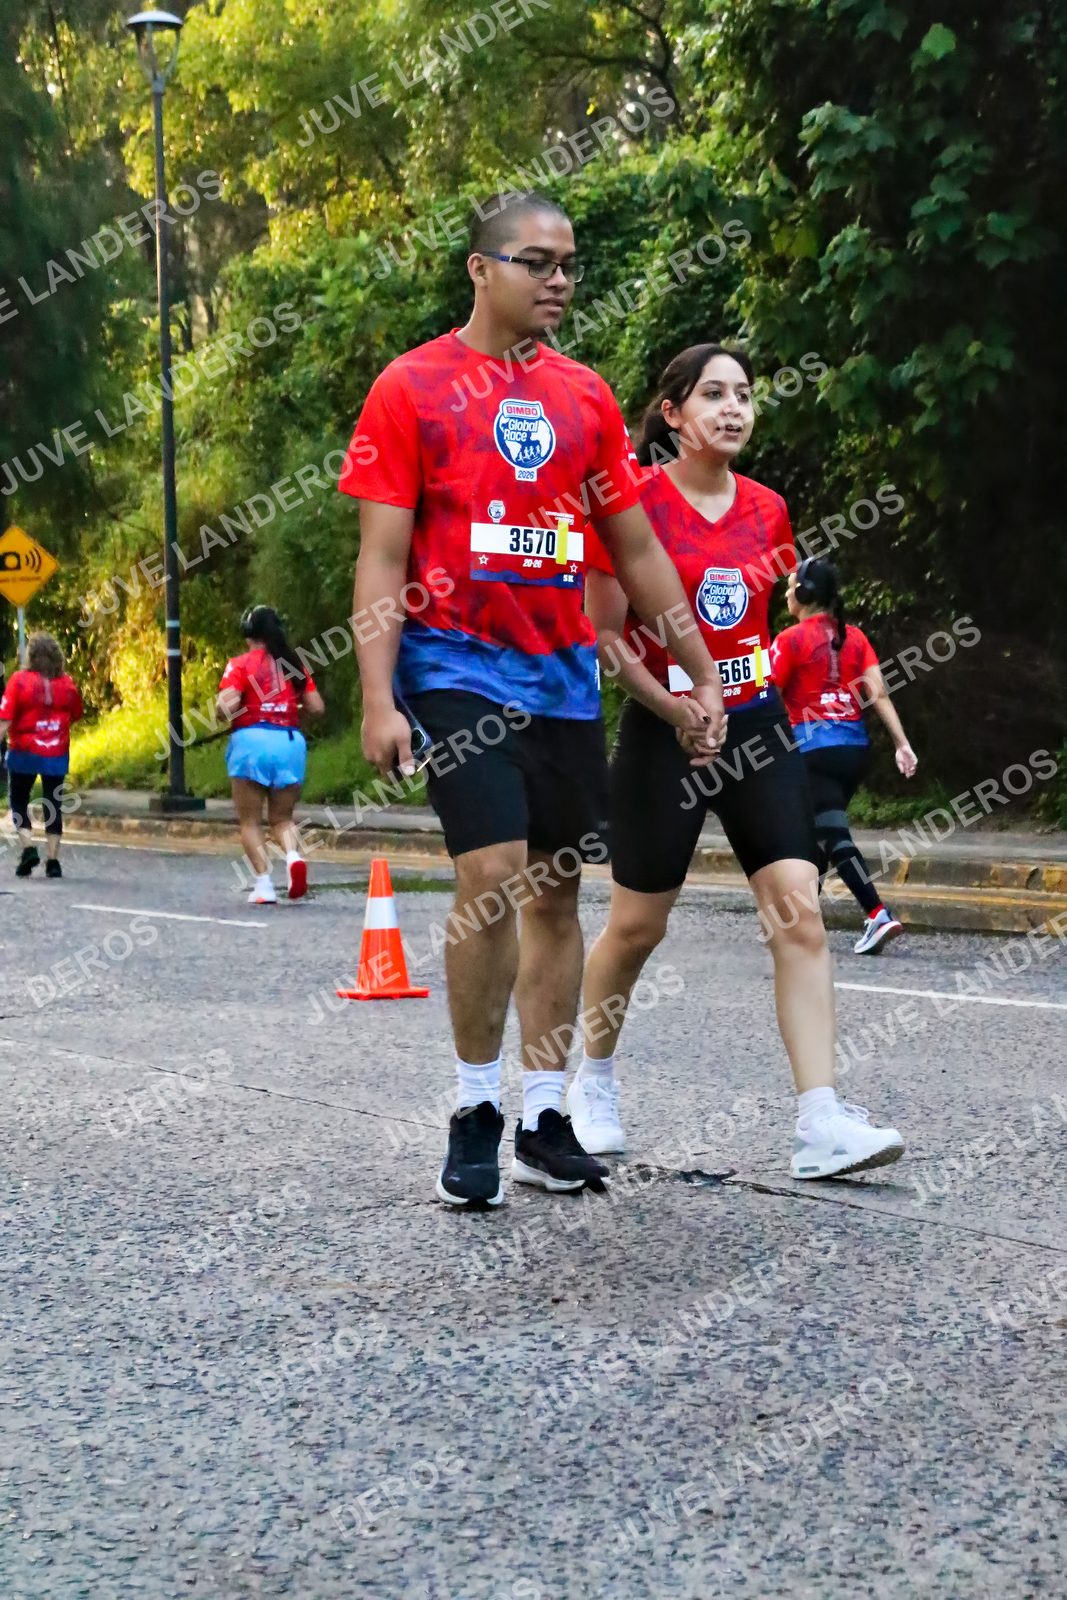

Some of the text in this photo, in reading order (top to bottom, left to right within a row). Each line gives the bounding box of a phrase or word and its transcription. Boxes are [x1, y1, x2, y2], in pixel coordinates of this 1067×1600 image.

[506, 405, 538, 416] BIMBO
[508, 418, 538, 432] Global
[503, 429, 528, 442] Race
[517, 470, 535, 480] 2026
[509, 527, 556, 556] 3570
[710, 584, 737, 596] Global
[704, 594, 726, 605] Race
[717, 656, 752, 685] 566
